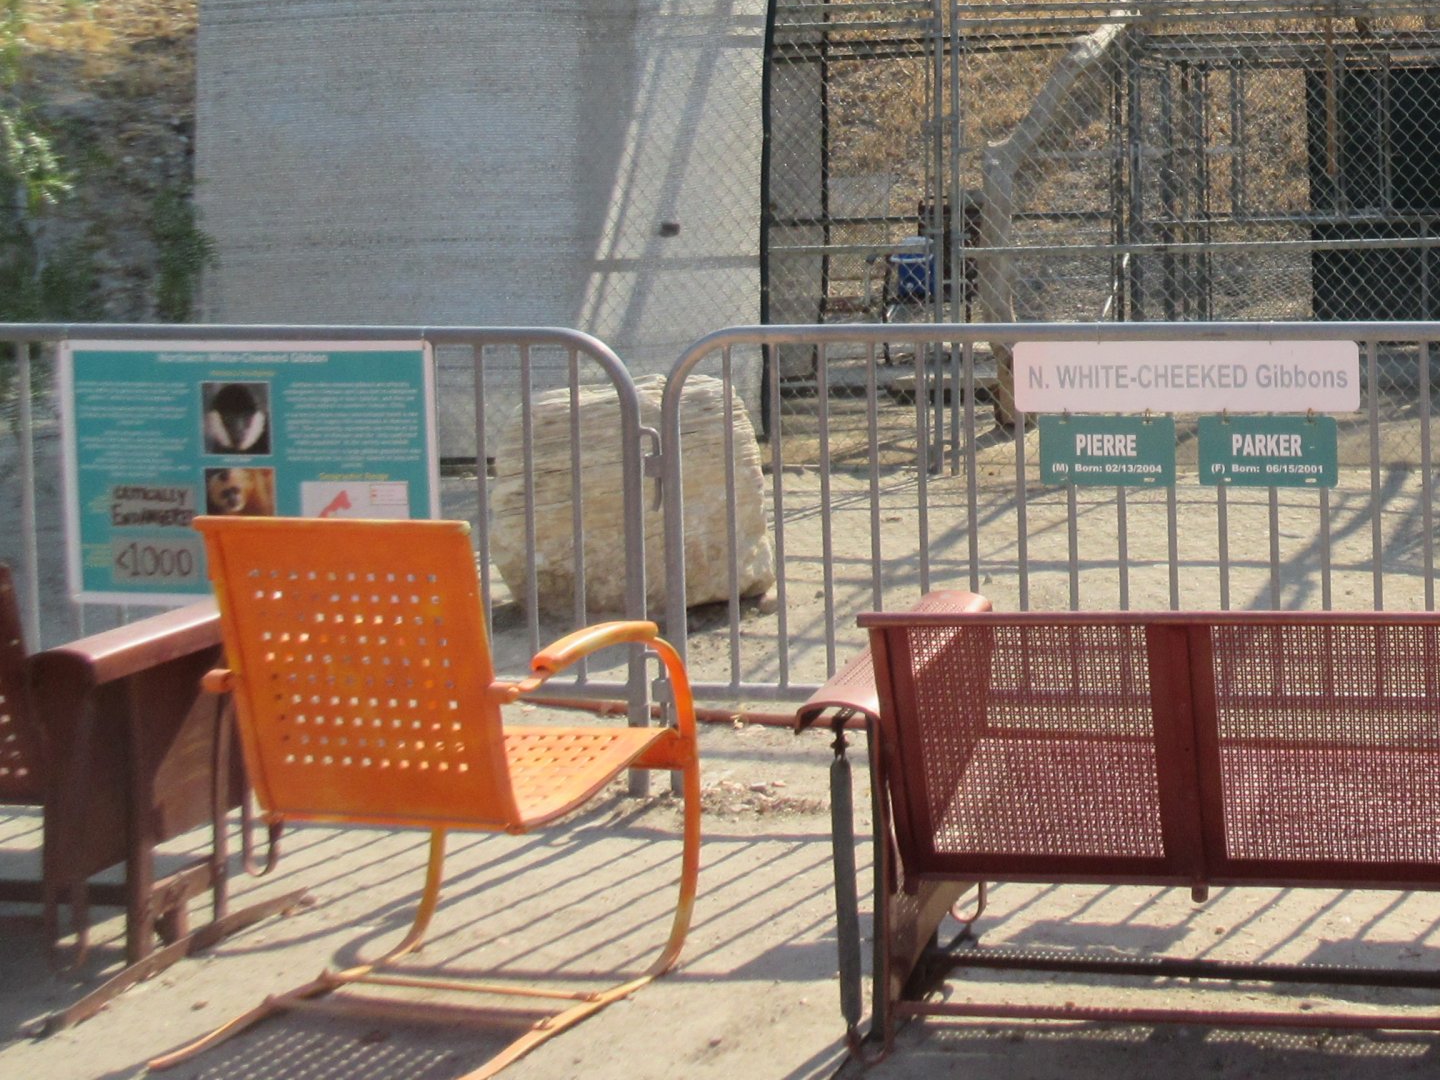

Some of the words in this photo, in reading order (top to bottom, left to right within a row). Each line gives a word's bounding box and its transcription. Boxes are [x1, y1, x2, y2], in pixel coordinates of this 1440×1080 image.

[1028, 366, 1049, 389] N.
[1057, 364, 1248, 389] WHITE-CHEEKED
[1255, 363, 1348, 389] Gibbons
[1075, 433, 1138, 457] PIERRE
[1231, 433, 1303, 457] PARKER
[1052, 463, 1069, 474] (M)
[1074, 463, 1102, 473] Born:
[1105, 464, 1163, 474] 02/13/2004
[1211, 464, 1226, 474] (F)
[1231, 464, 1260, 474] Born:
[1265, 464, 1324, 474] 06/15/2001
[115, 542, 194, 577] <1000
